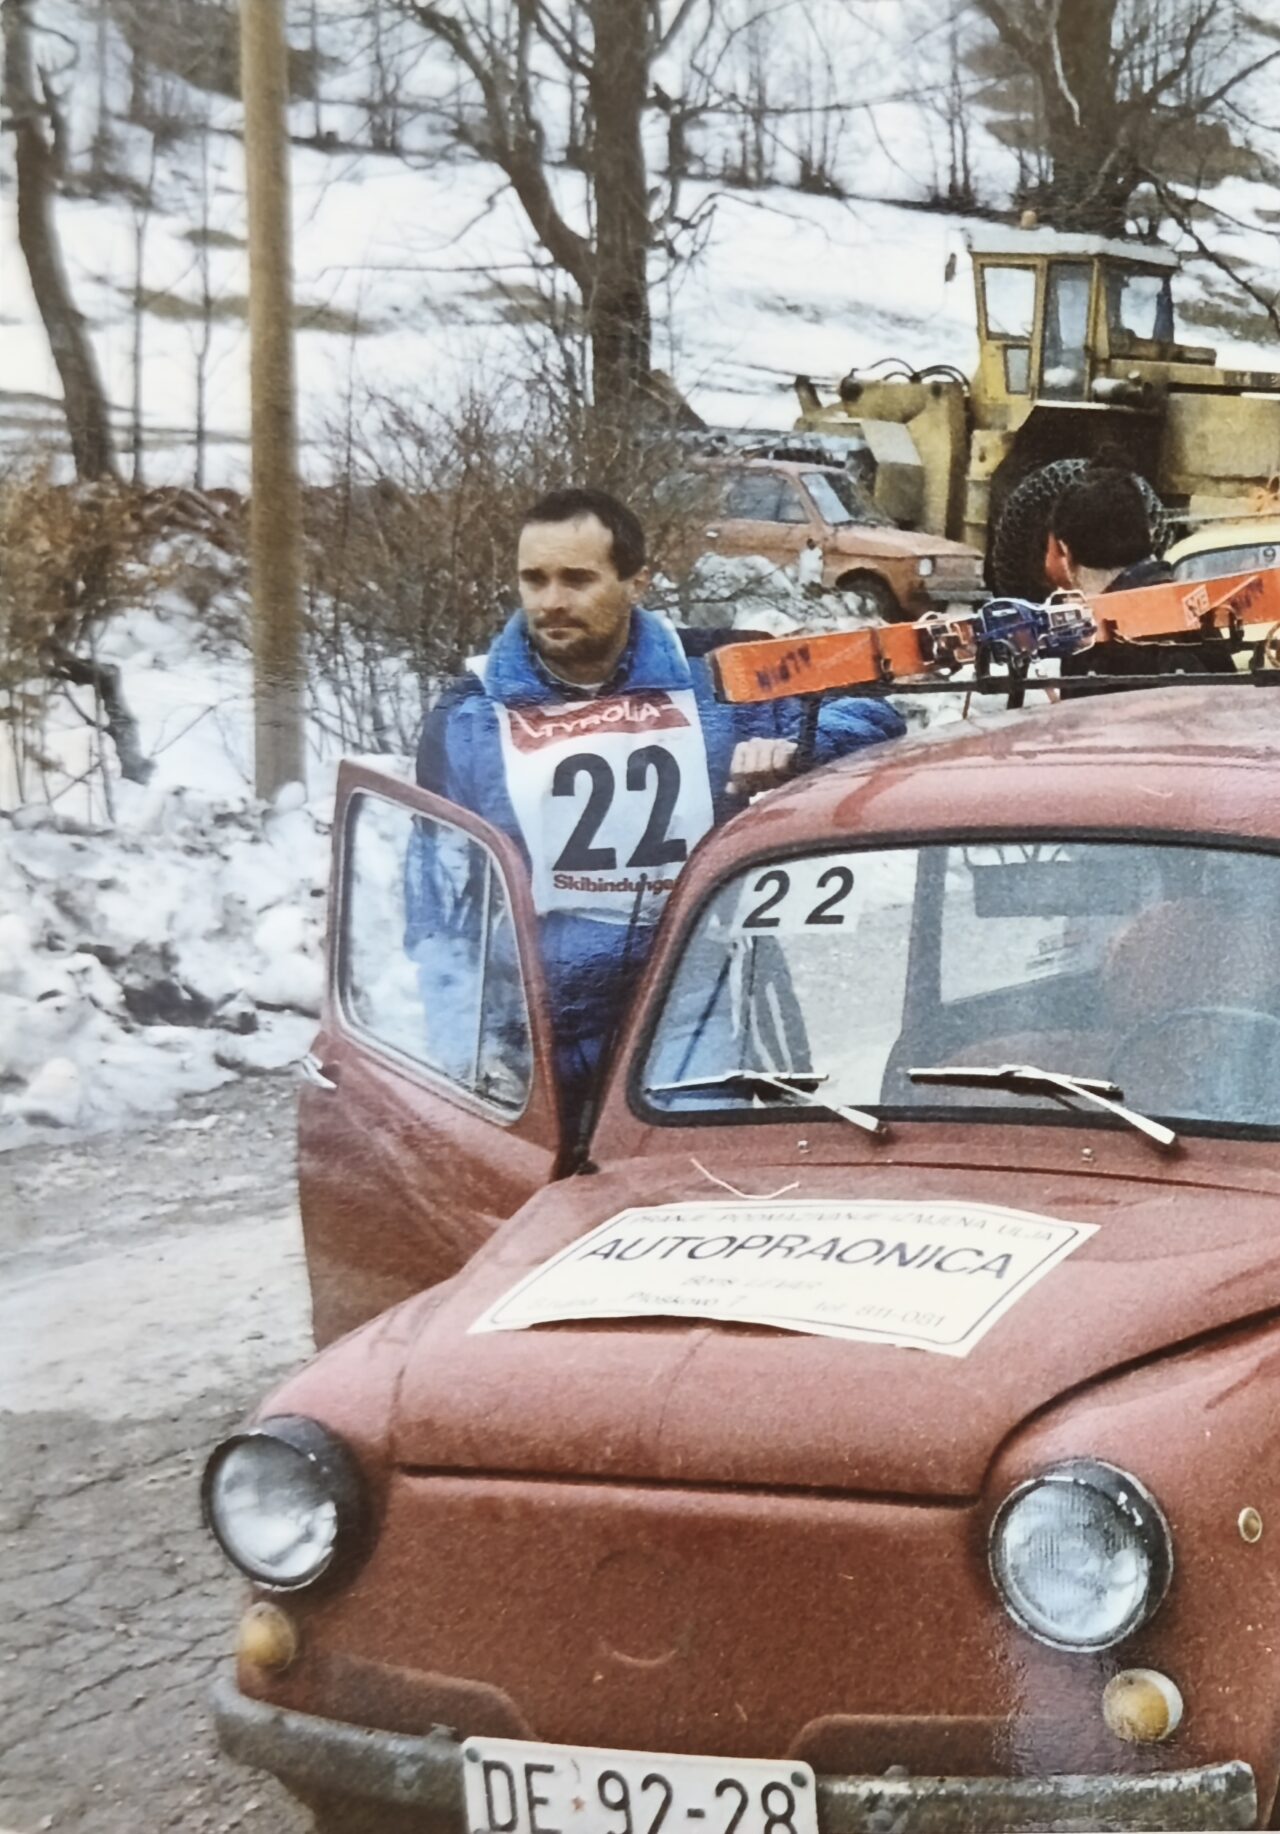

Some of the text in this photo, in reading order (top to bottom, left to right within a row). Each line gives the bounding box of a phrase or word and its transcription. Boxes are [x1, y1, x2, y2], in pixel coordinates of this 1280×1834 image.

[552, 745, 687, 871] 22
[743, 866, 855, 929] 22
[583, 1234, 1013, 1279] AUTOPRAONICA
[482, 1760, 563, 1834] DE
